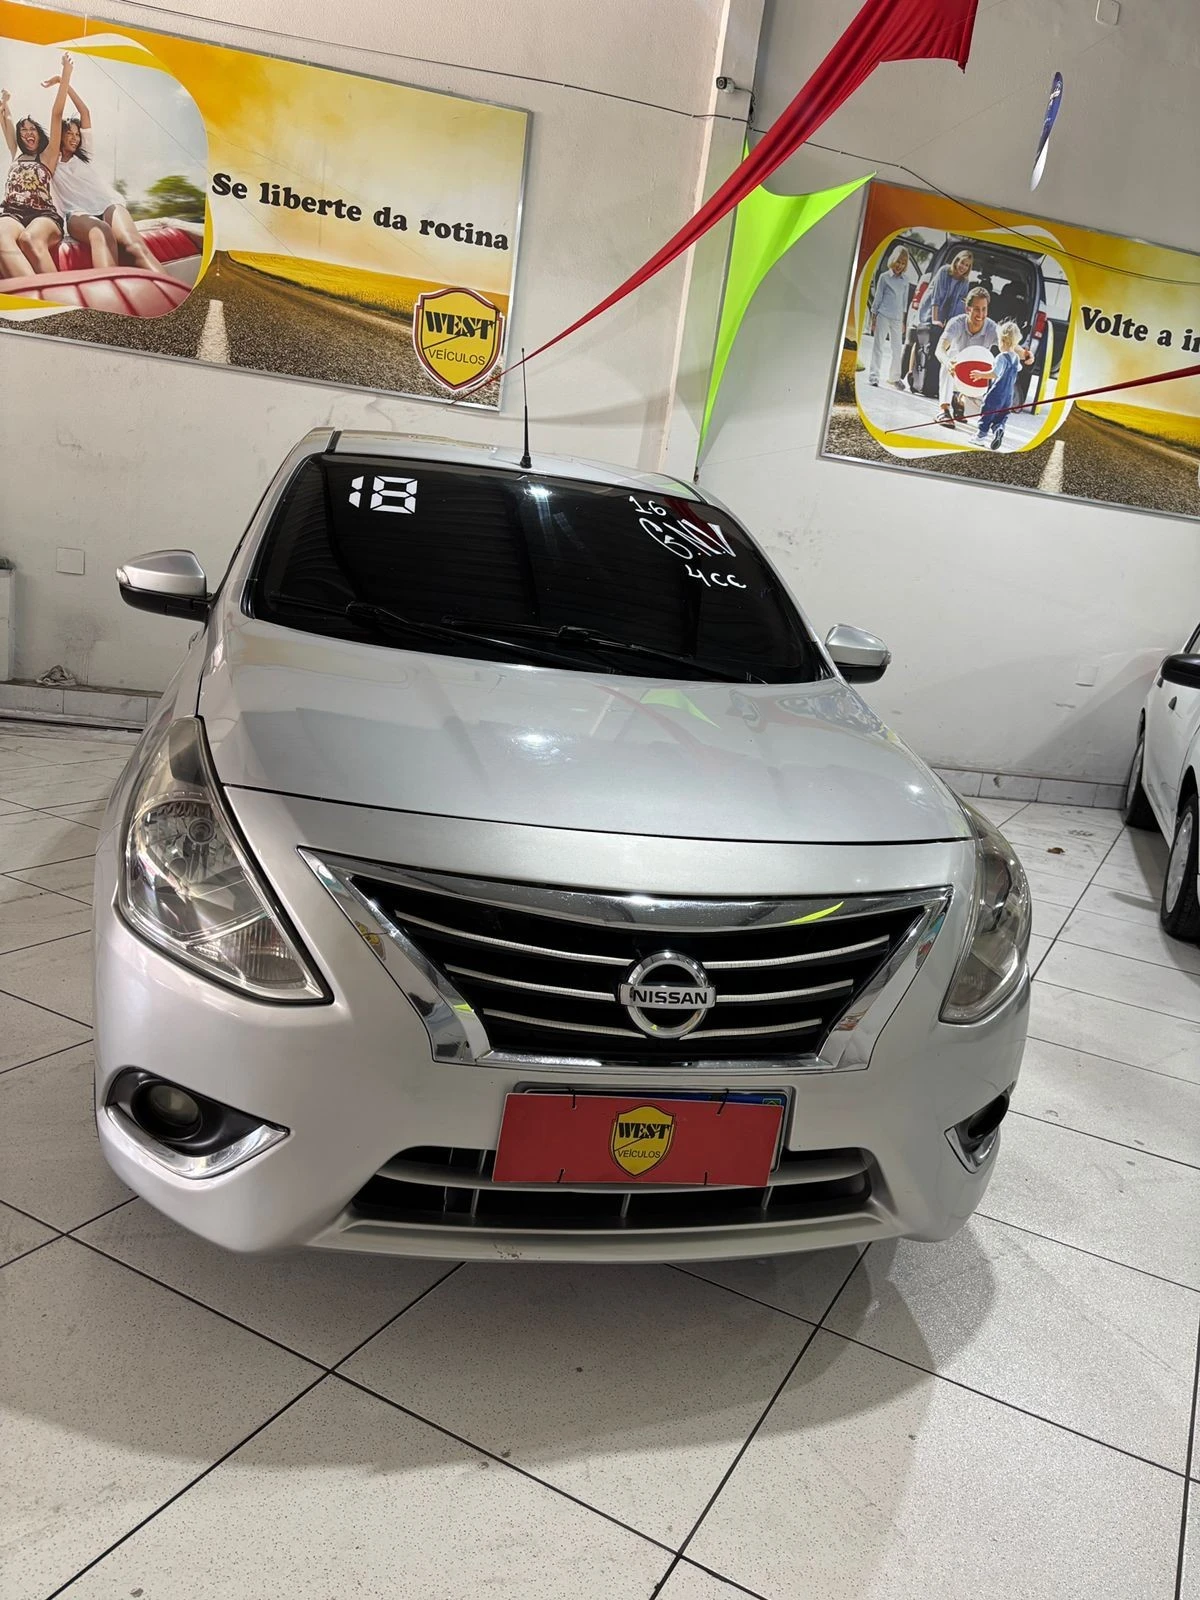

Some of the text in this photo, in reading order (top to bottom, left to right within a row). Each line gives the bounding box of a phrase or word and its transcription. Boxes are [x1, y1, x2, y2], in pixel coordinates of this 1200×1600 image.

[211, 172, 509, 251] Se liberte da rotina
[425, 310, 495, 340] WEST
[1081, 306, 1149, 341] Volte
[1157, 329, 1173, 347] a
[428, 348, 486, 366] VEÍCULOS
[348, 475, 418, 515] 18
[632, 989, 708, 1005] NISSAN
[618, 1122, 671, 1141] WEST
[617, 1148, 661, 1160] VEÍCULOS
